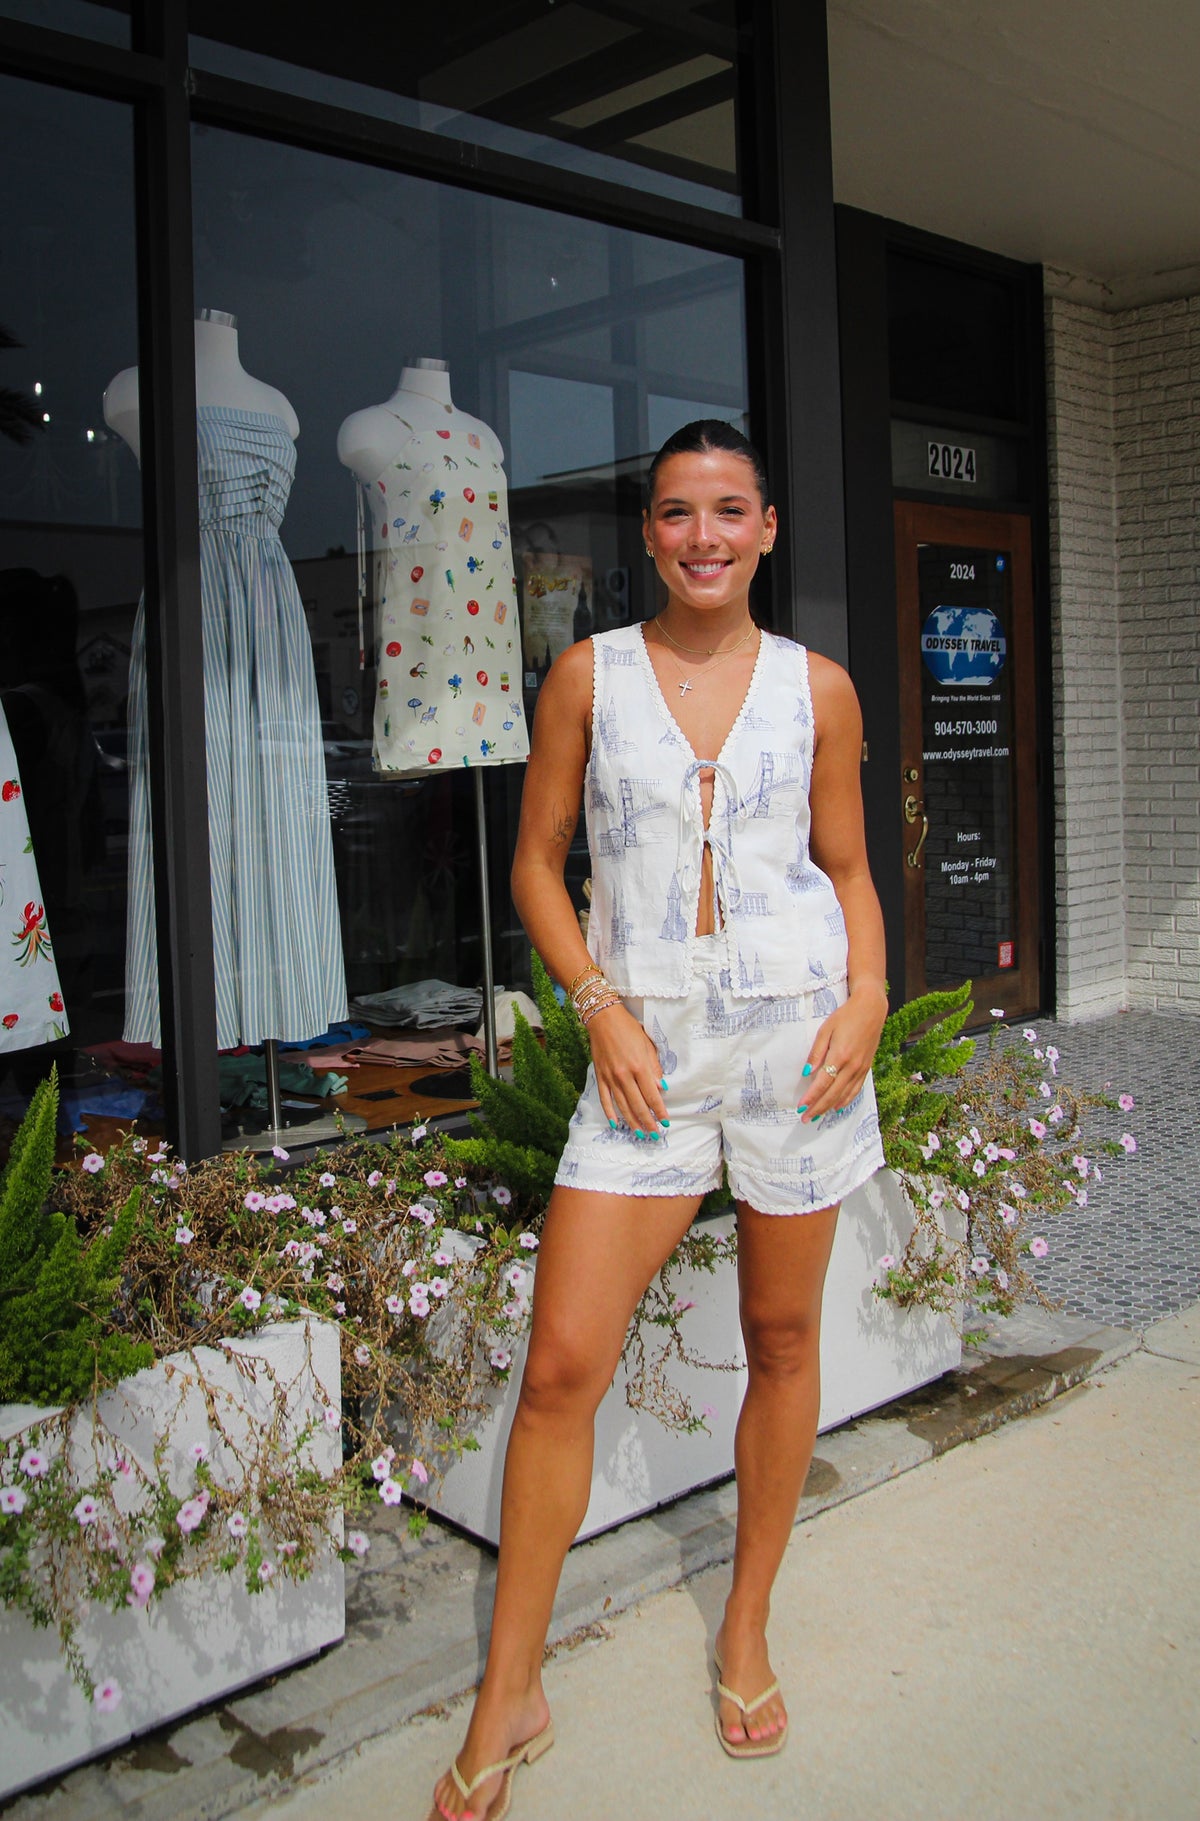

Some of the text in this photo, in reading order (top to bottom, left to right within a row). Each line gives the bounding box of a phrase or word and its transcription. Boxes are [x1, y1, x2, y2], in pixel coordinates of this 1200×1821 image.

[929, 443, 975, 481] 2024
[950, 563, 975, 581] 2024
[926, 637, 1001, 652] ODYSSEY TRAVEL
[931, 694, 950, 704] Bringing
[966, 694, 979, 702] World
[979, 694, 991, 702] Since
[934, 720, 998, 736] 904-570-3000
[922, 747, 1010, 761] www.odysseytravel.com
[957, 832, 981, 842] Hours:
[941, 860, 970, 872] Monday
[974, 856, 997, 868] Friday
[949, 874, 969, 885] 10am
[974, 871, 990, 883] 4pm
